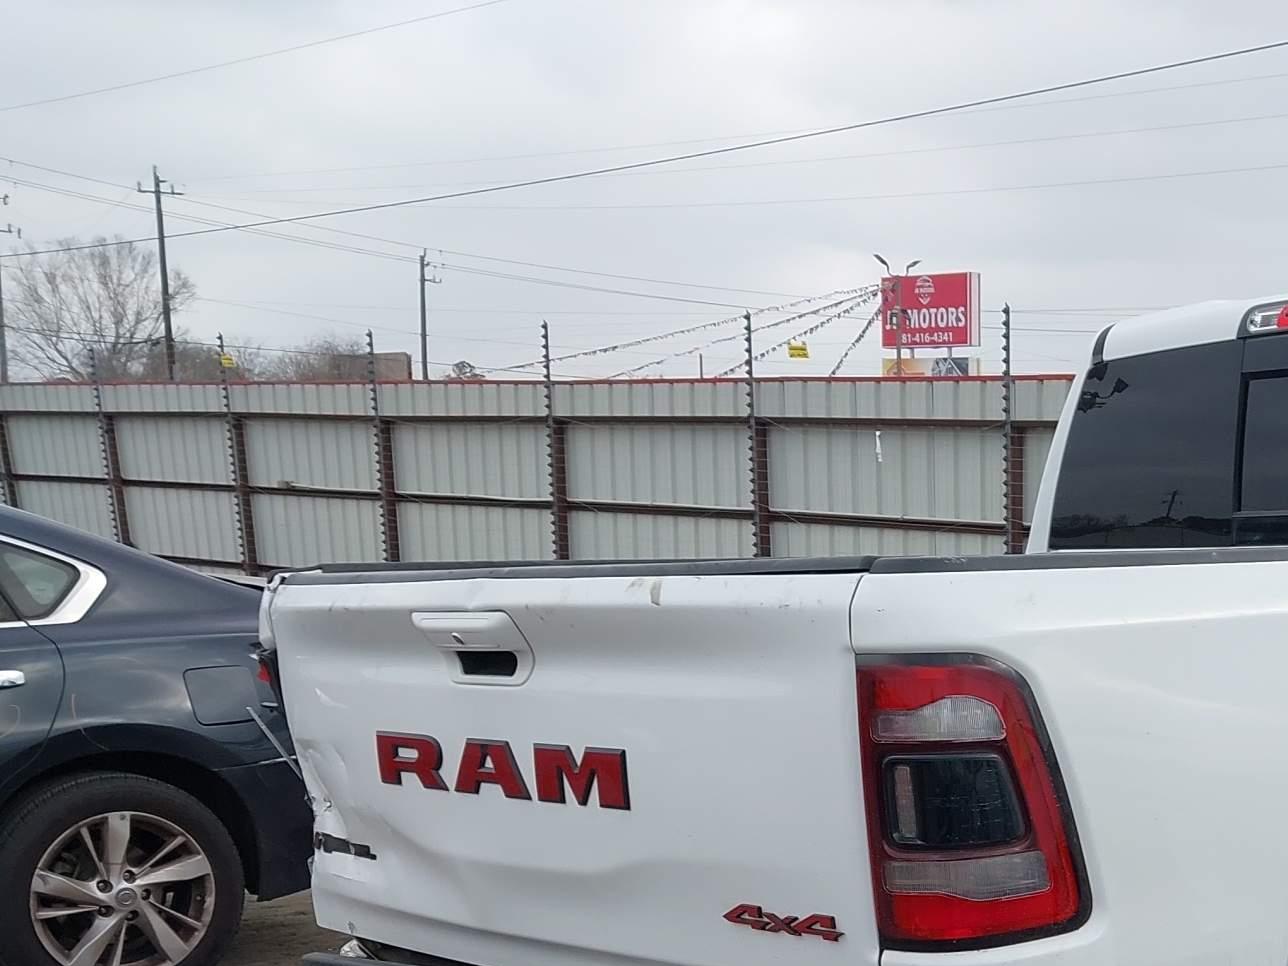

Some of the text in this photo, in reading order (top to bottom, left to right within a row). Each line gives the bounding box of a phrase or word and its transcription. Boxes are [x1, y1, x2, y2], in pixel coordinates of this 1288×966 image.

[906, 306, 966, 329] MOTORS
[901, 331, 954, 344] 81-416-4341
[375, 730, 632, 812] RAM
[721, 903, 846, 942] 4x4
